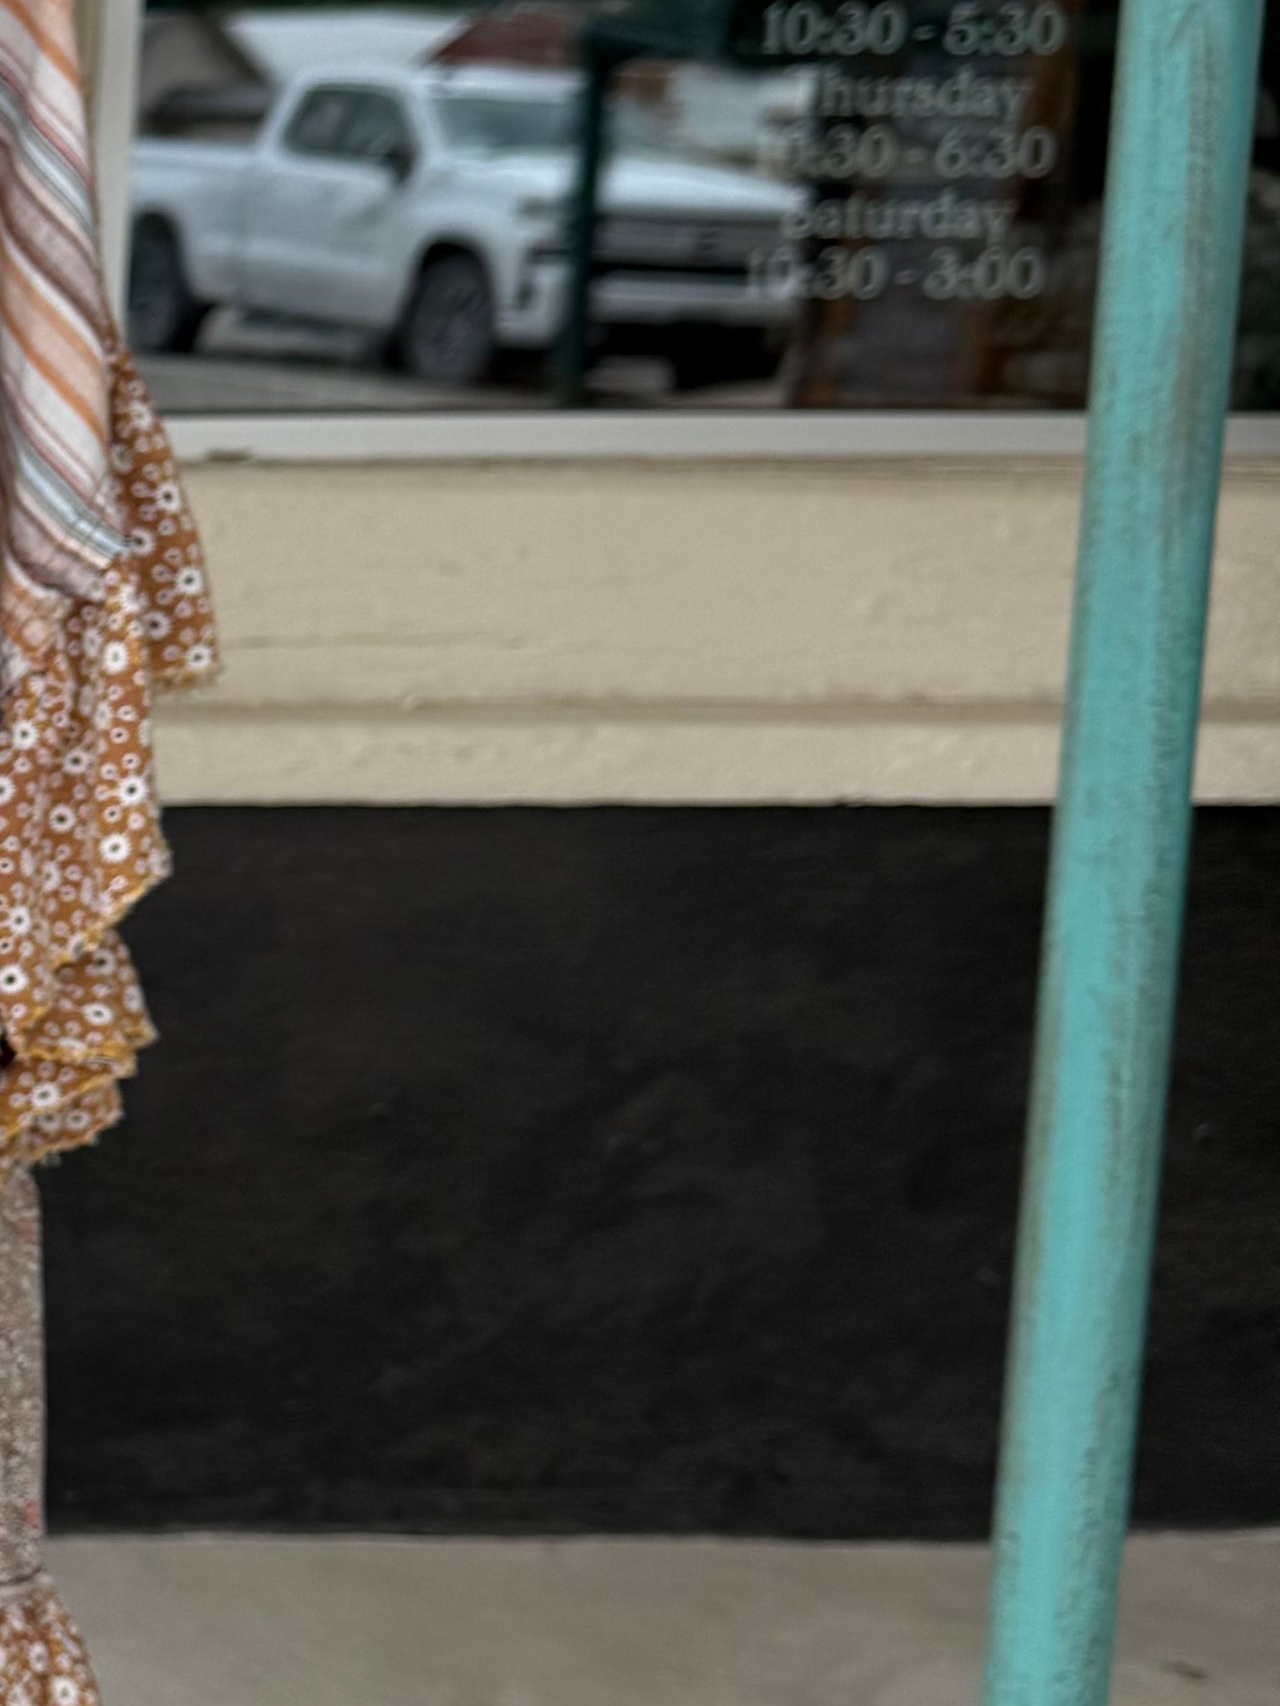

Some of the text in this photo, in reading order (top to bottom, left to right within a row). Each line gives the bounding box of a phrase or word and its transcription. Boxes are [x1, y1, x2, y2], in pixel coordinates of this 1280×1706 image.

[762, 0, 907, 56] 10:30
[943, 0, 1068, 56] 5:30
[935, 124, 1057, 178] 6:30
[780, 186, 1020, 245] Saturday
[923, 245, 1047, 300] 3:00
